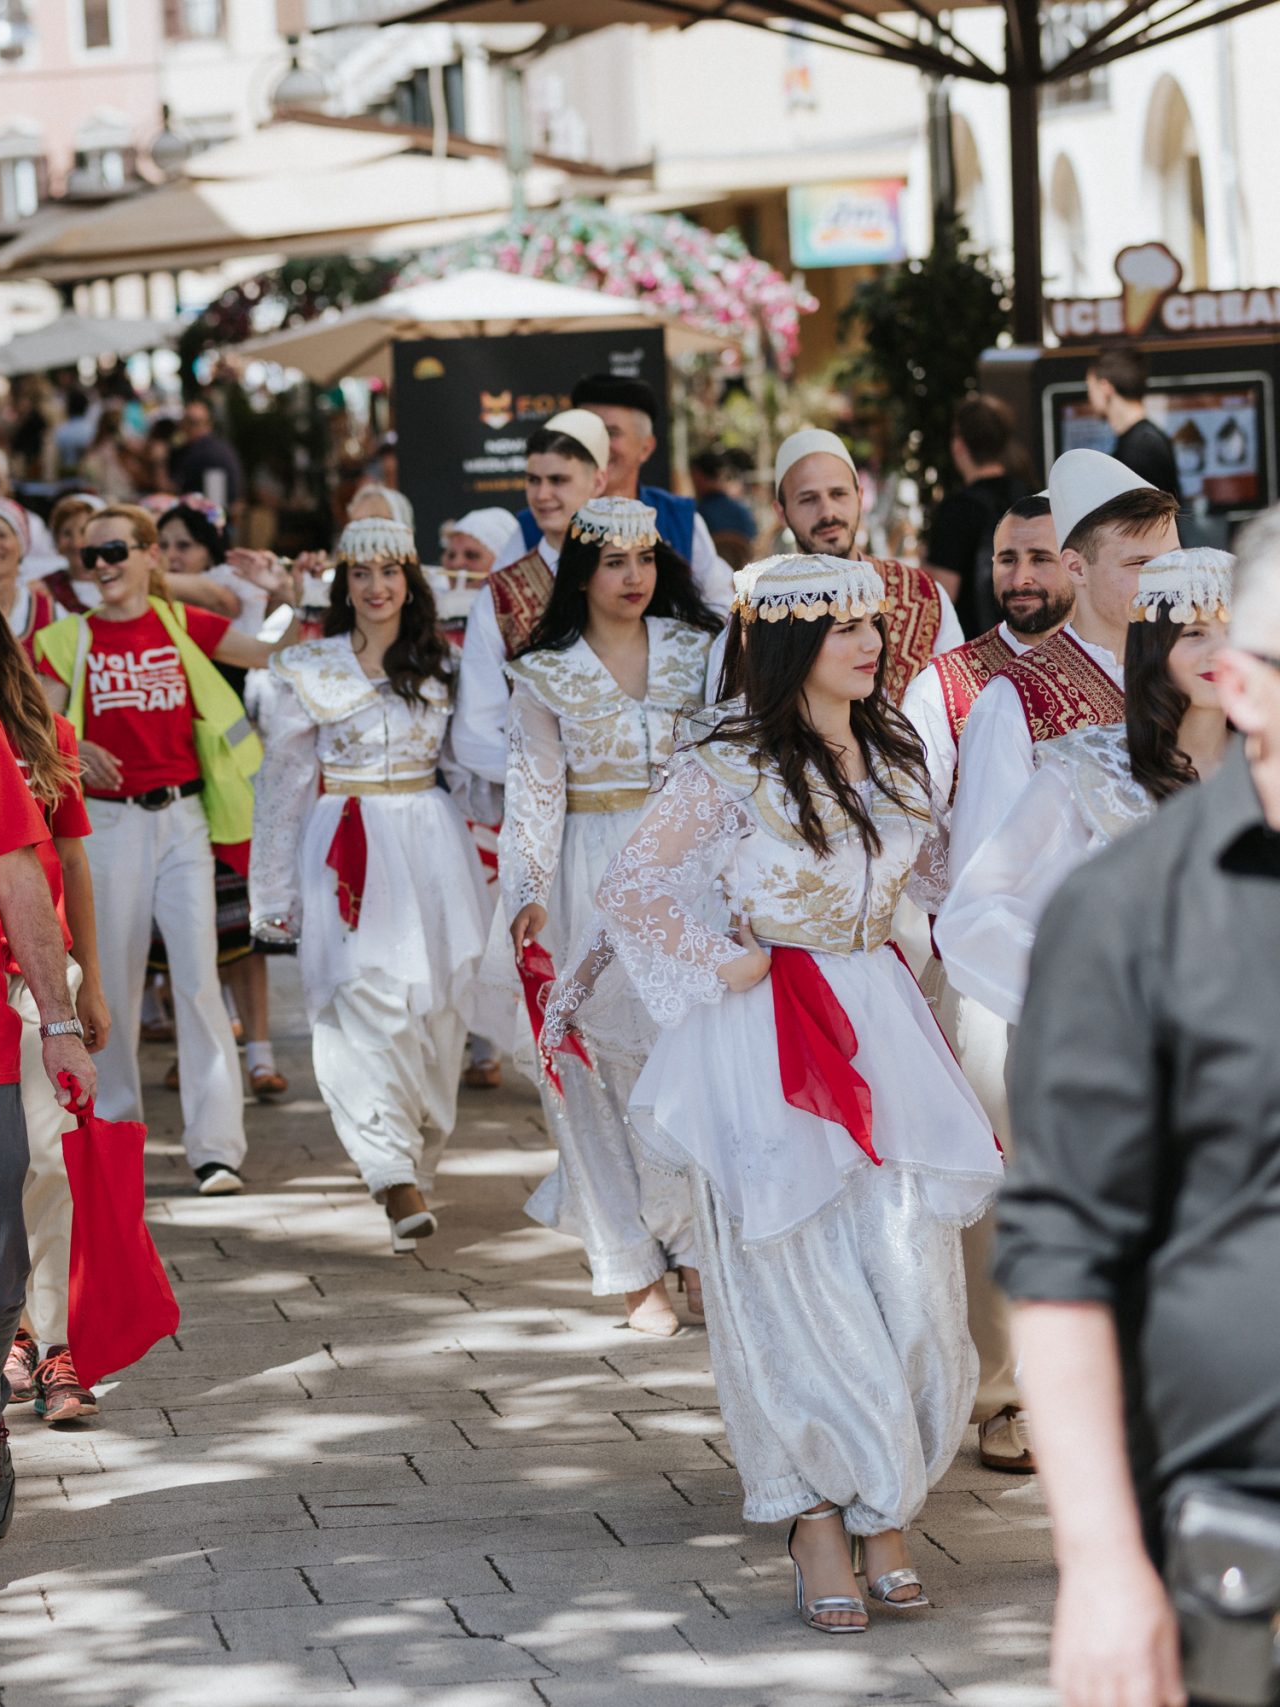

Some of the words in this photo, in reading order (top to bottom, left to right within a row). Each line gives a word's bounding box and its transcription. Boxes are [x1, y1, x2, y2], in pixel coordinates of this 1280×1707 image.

[1052, 299, 1124, 336] ICE
[1162, 289, 1280, 331] CREA
[87, 645, 180, 672] VOLO
